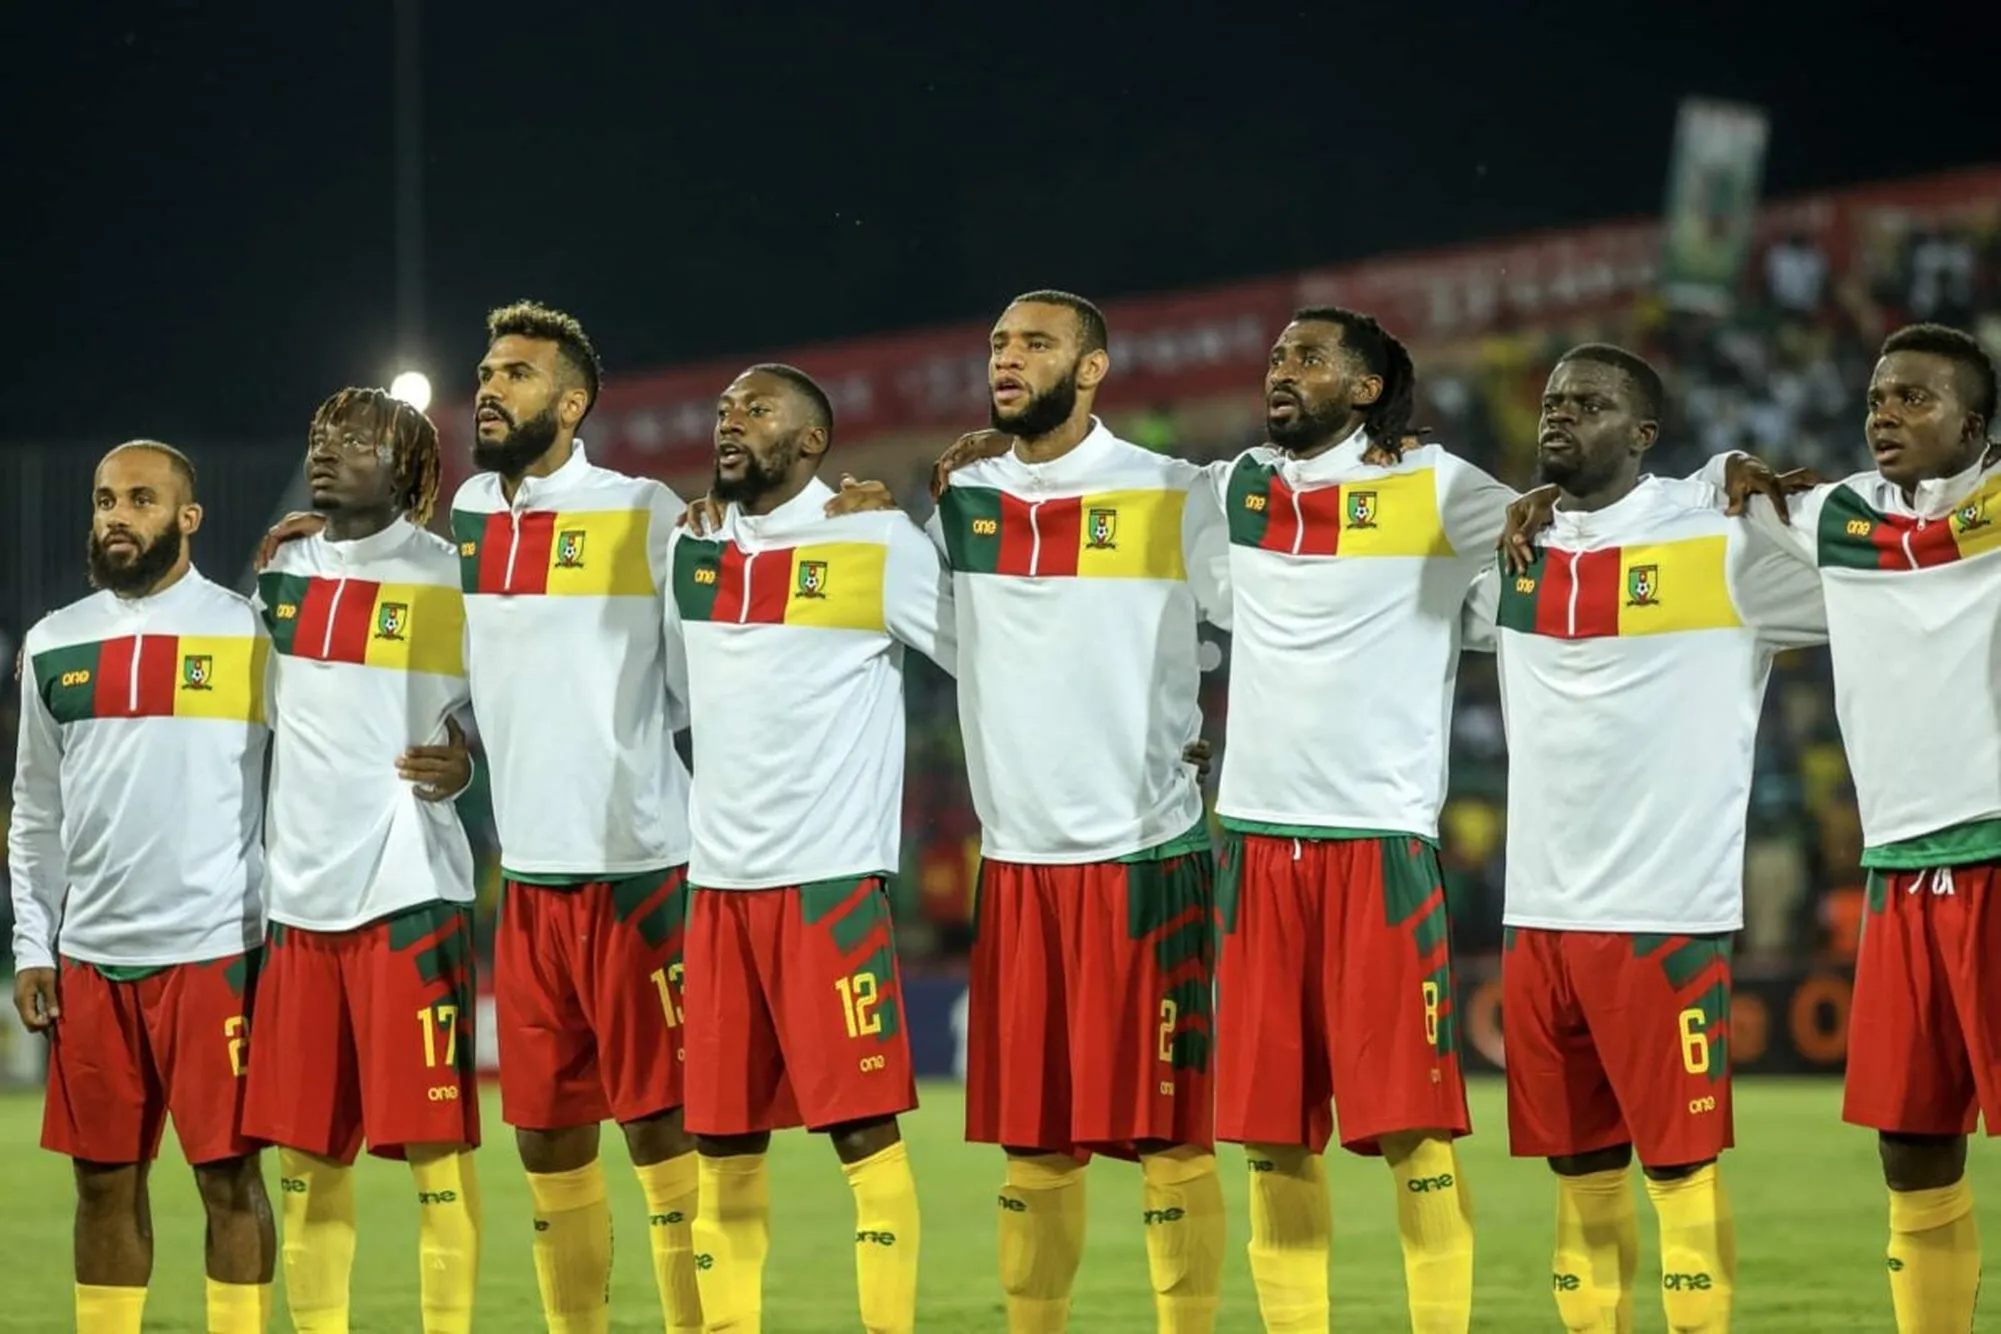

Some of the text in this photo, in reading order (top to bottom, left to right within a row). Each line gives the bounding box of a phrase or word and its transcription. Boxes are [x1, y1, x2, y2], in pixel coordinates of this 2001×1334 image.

[973, 519, 997, 535] one
[1847, 519, 1870, 536] one
[694, 568, 715, 584] one
[1516, 576, 1535, 593] one
[276, 604, 296, 619] one
[62, 669, 90, 686] one
[835, 972, 881, 1039] 12
[1422, 981, 1438, 1044] 8
[417, 1005, 458, 1068] 17
[1159, 998, 1177, 1063] 2
[225, 1015, 249, 1077] 2
[1679, 1007, 1710, 1074] 6
[860, 1054, 885, 1072] one
[428, 1085, 458, 1101] one
[1688, 1095, 1715, 1114] one
[1248, 1159, 1274, 1172] ne
[281, 1177, 306, 1193] ne
[1408, 1173, 1452, 1192] one
[998, 1195, 1027, 1212] ne
[649, 1211, 684, 1226] ne
[1553, 1273, 1580, 1291] ne
[1664, 1273, 1711, 1291] one
